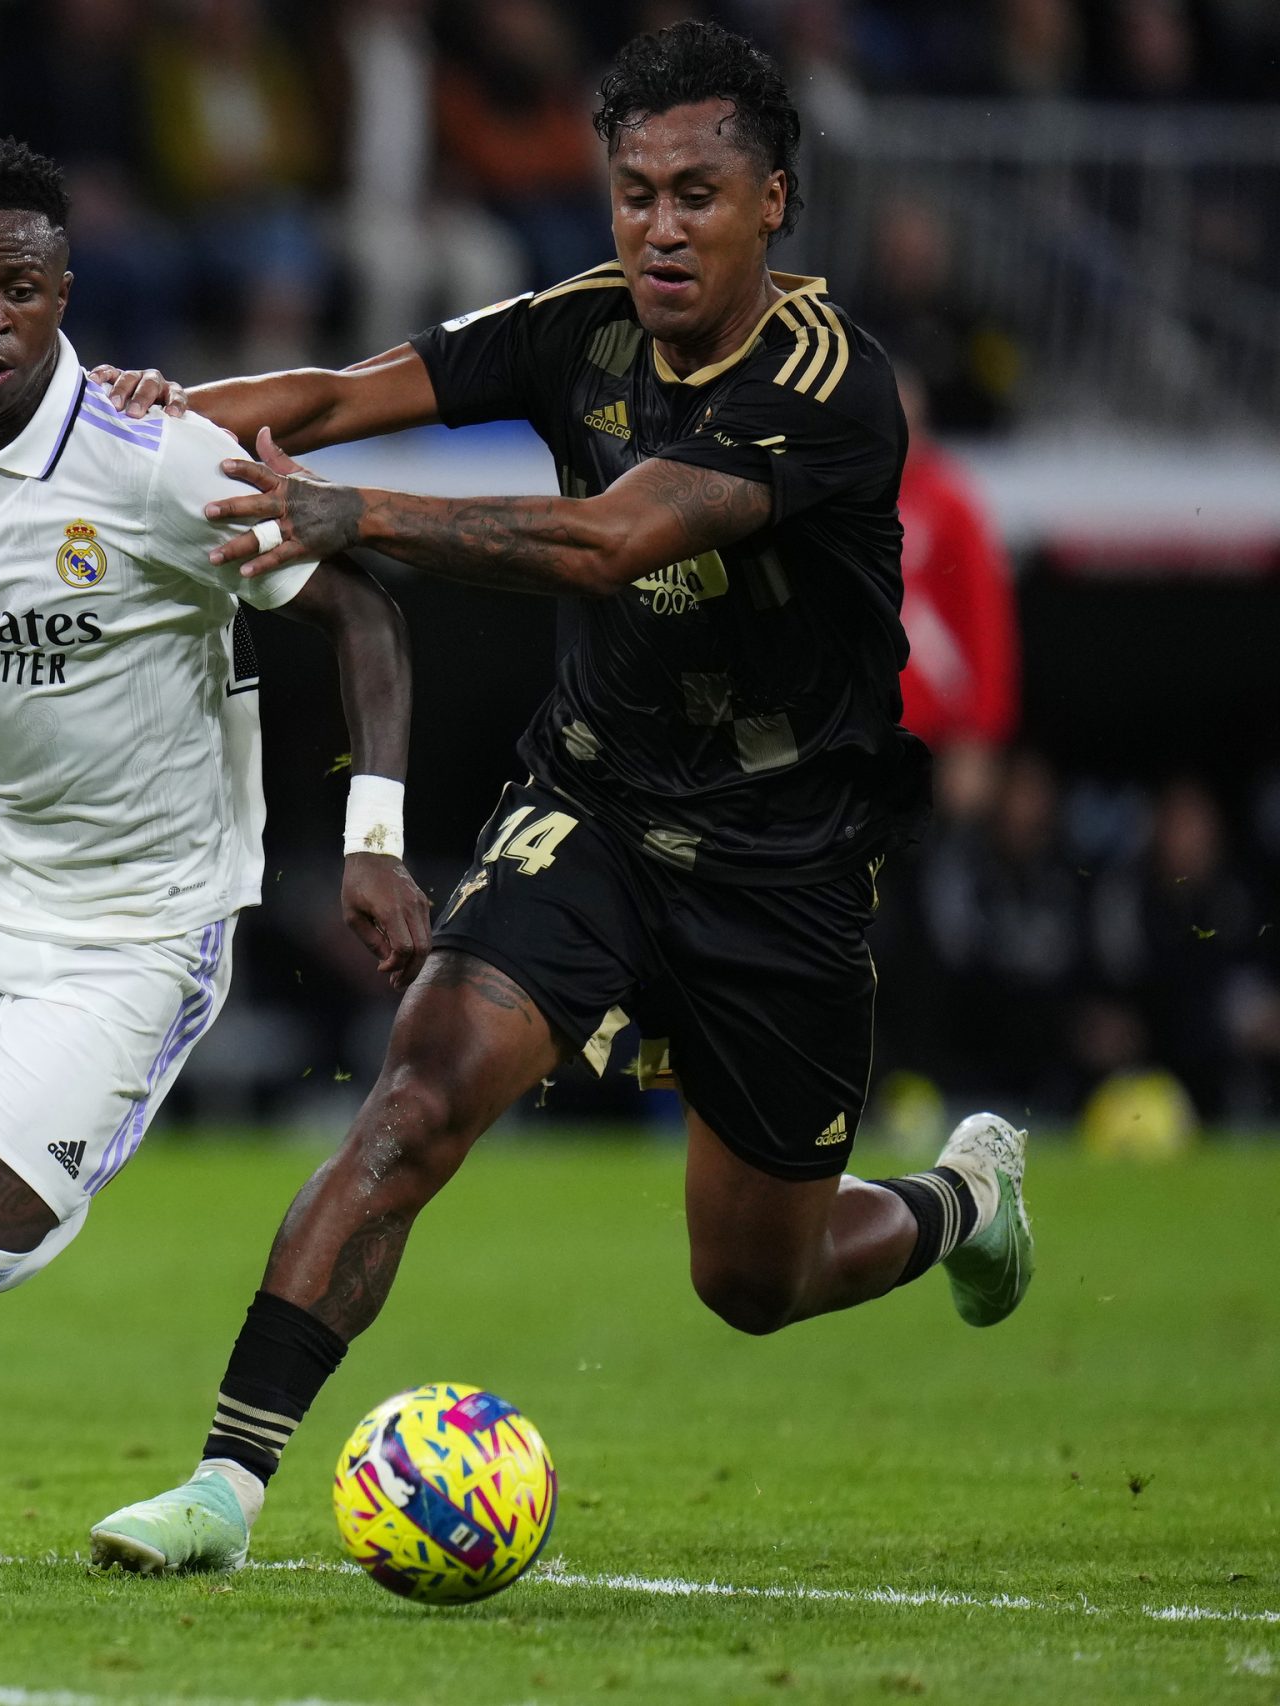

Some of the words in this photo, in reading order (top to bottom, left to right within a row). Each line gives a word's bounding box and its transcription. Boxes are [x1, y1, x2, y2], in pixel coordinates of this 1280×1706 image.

[583, 415, 632, 440] adidas
[481, 805, 580, 876] 14
[47, 1142, 80, 1180] adidas
